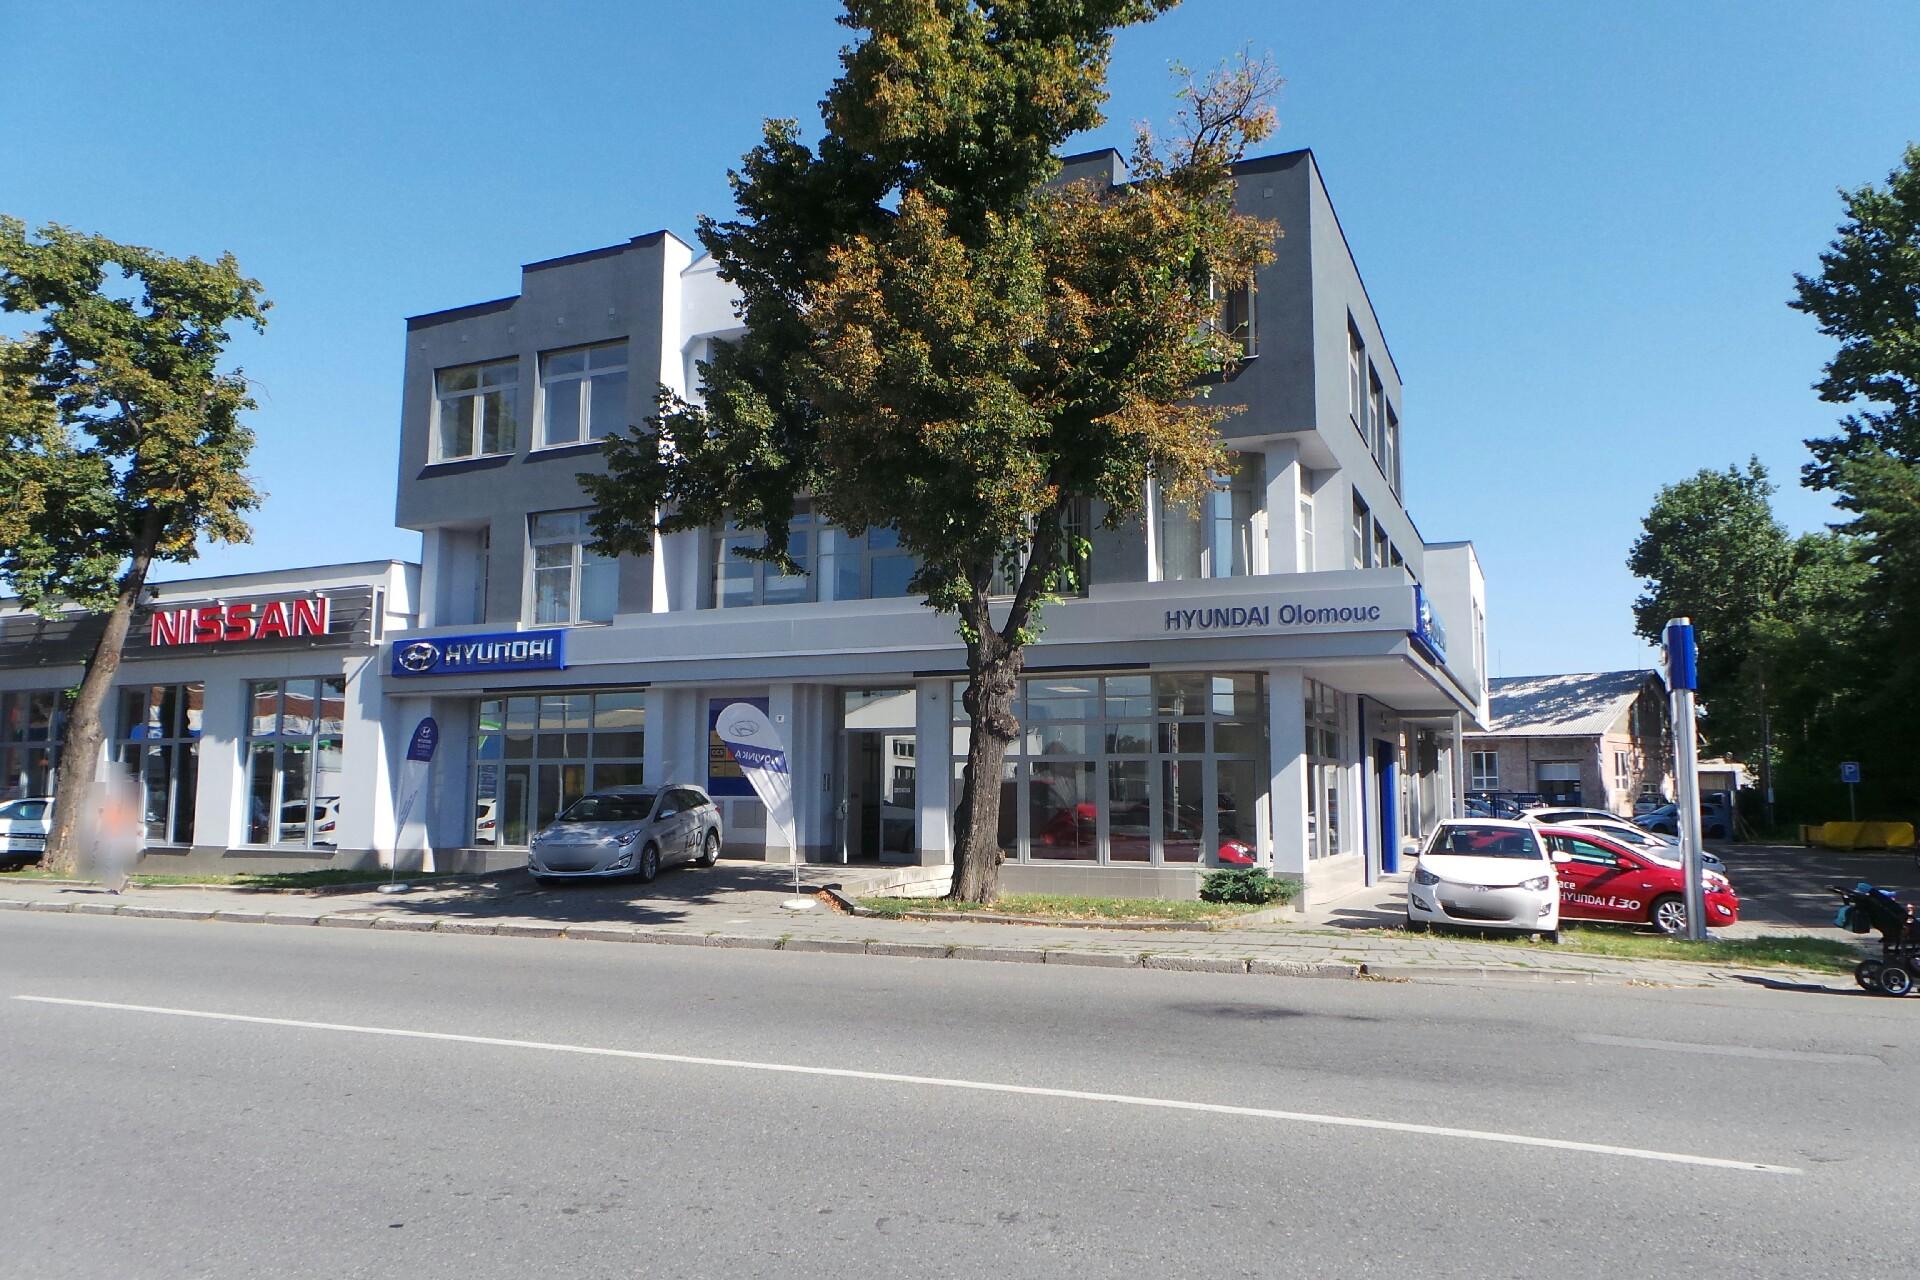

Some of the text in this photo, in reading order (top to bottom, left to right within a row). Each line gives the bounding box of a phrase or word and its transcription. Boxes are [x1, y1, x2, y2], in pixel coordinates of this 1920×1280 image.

[151, 597, 331, 646] NISSAN
[1165, 604, 1381, 631] HYUNDAI Olomouc
[445, 638, 554, 666] HYUNDAI
[1559, 892, 1605, 906] HYUNDAI
